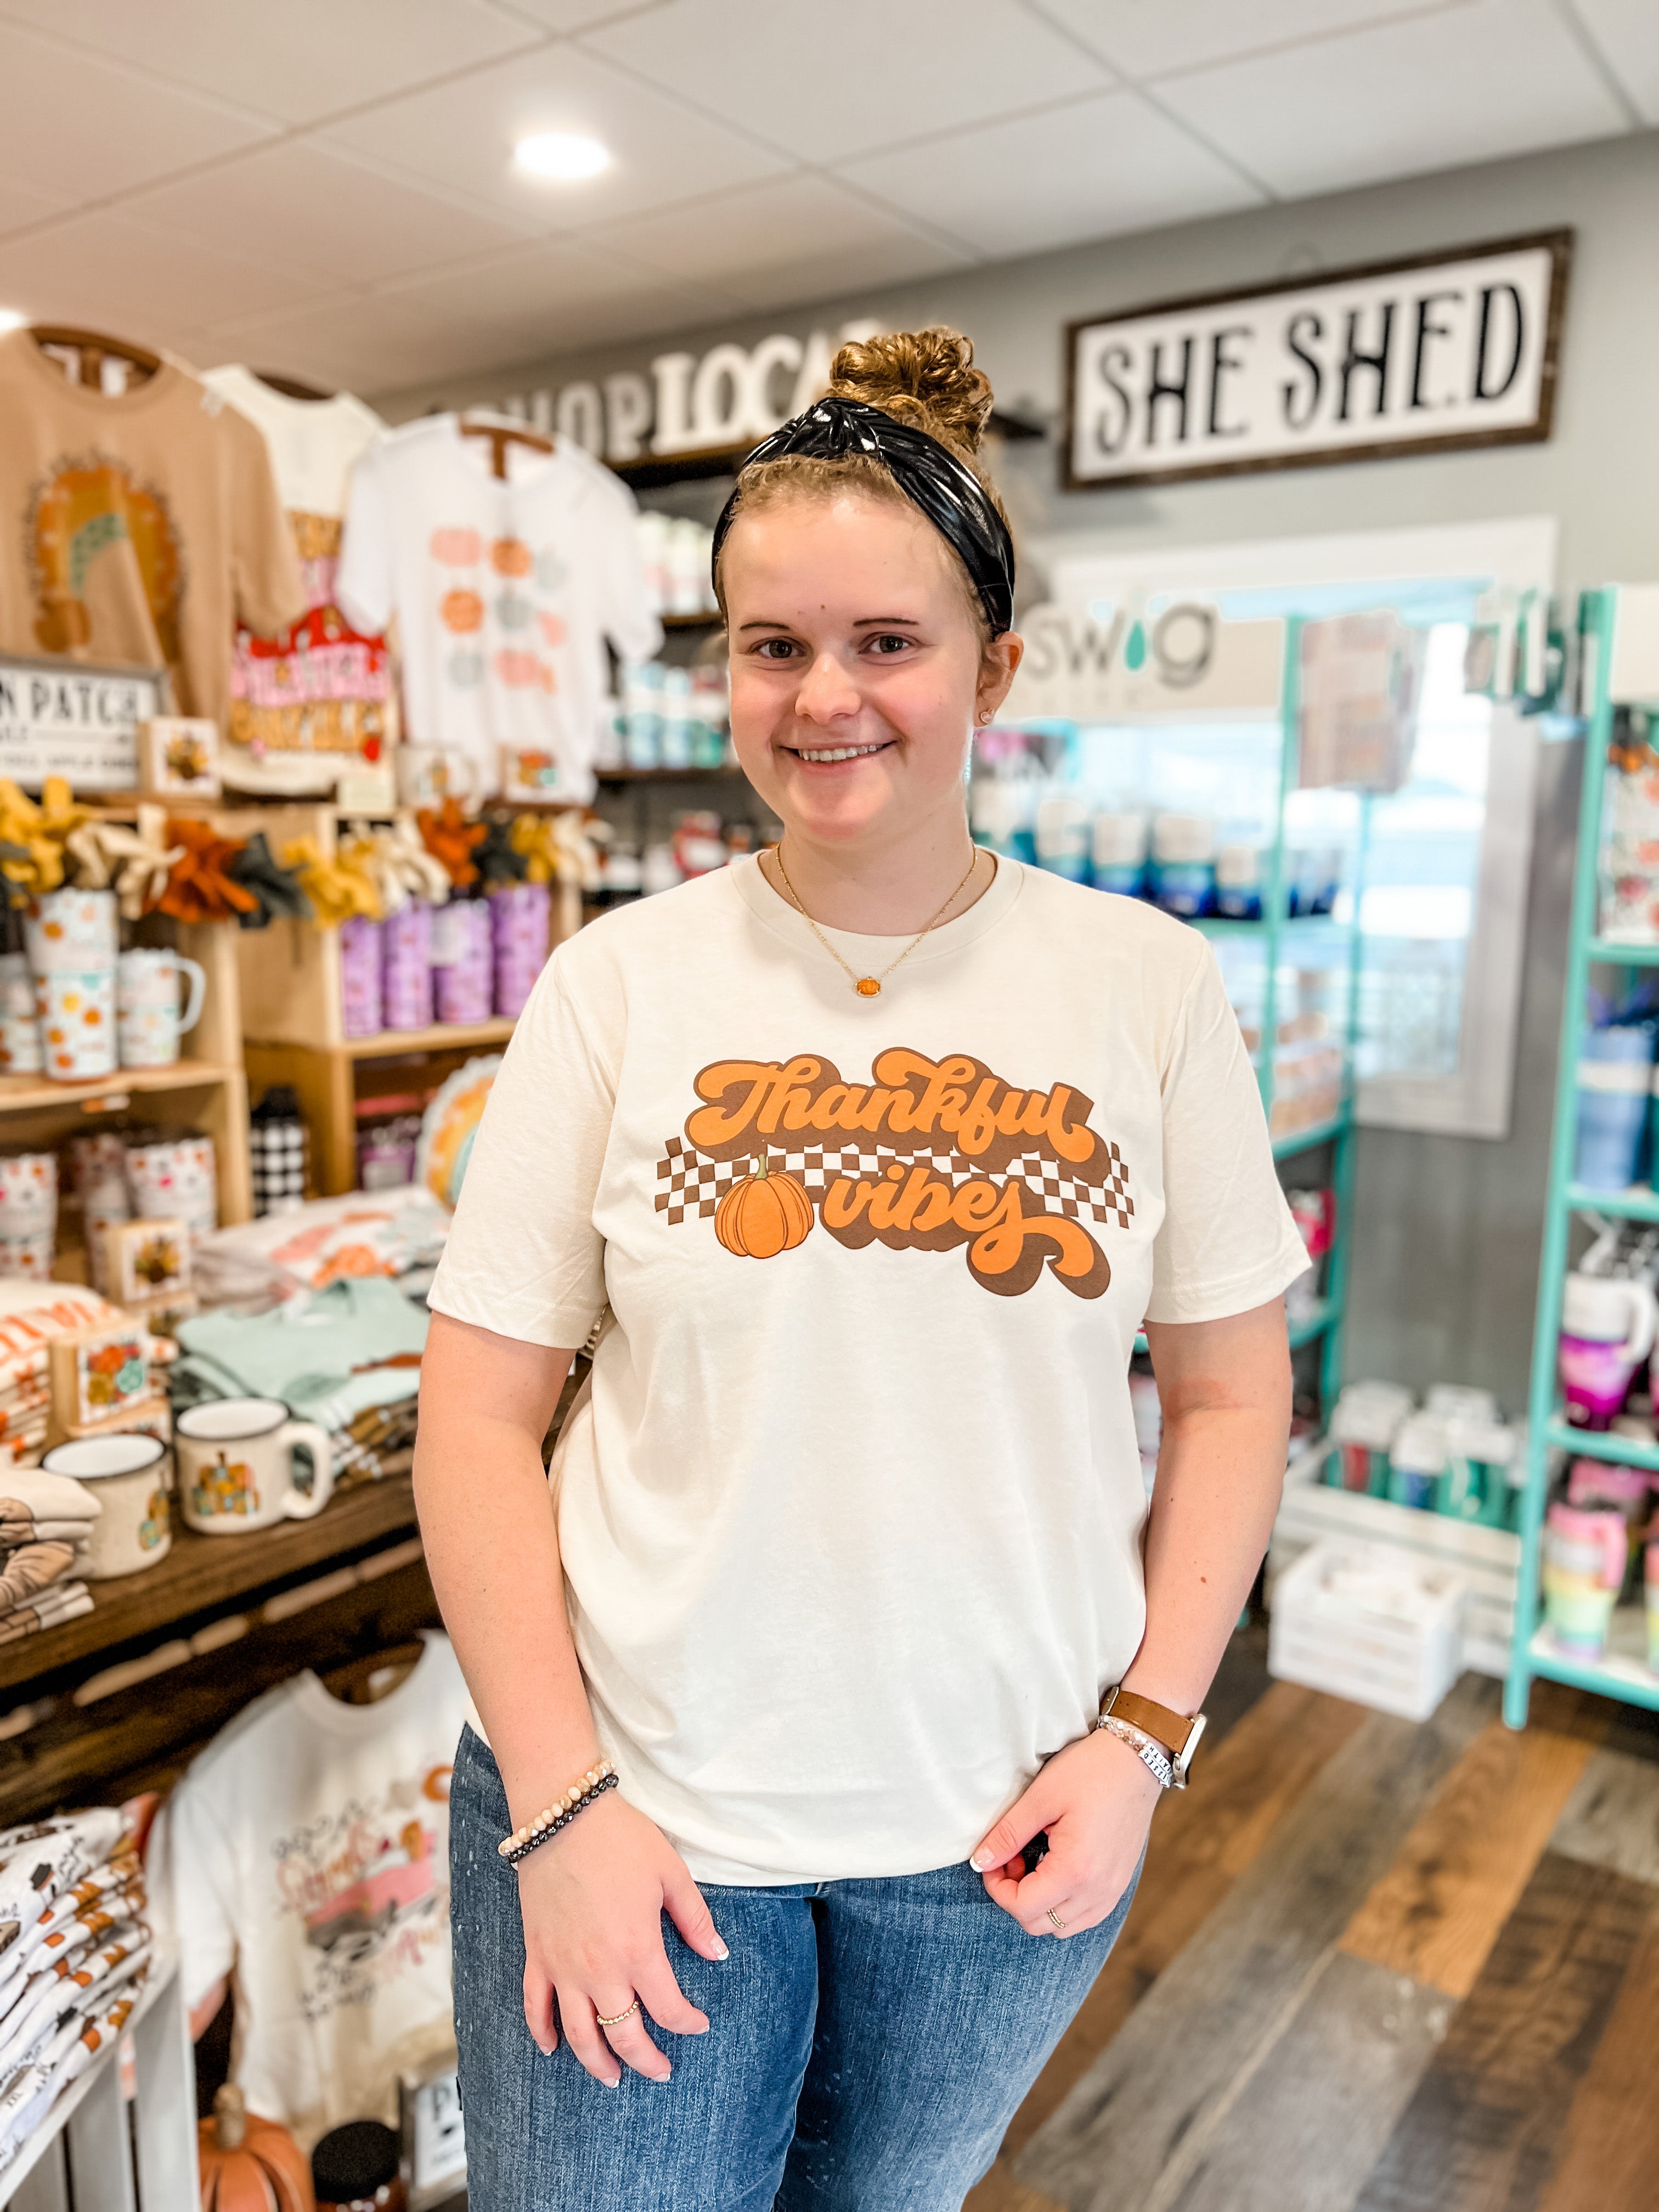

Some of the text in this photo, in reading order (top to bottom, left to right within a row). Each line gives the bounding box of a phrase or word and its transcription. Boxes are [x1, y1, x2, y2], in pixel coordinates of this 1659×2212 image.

[470, 319, 883, 462] HOP LOCA
[1097, 282, 1525, 455] SHE SHED
[686, 1048, 1103, 1167] Thankful
[822, 1164, 1103, 1286] vibes
